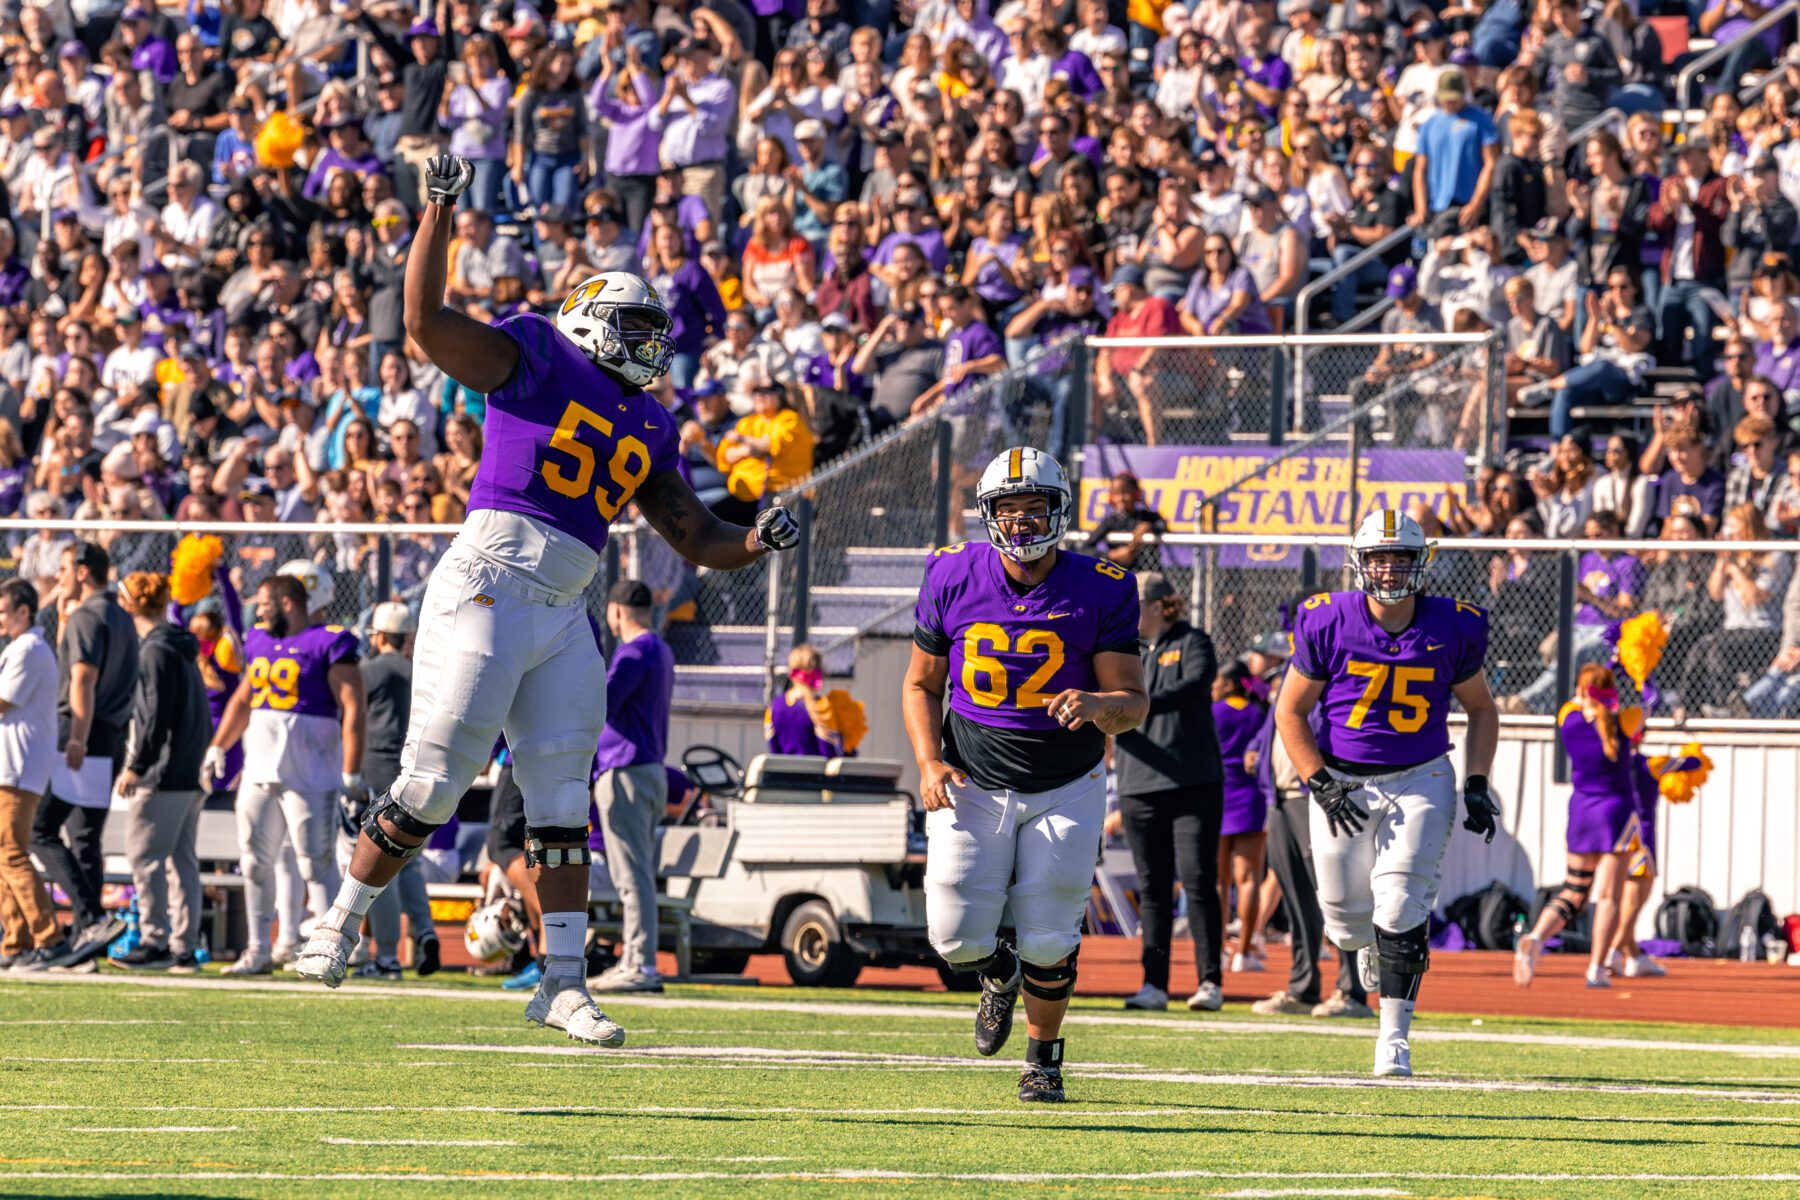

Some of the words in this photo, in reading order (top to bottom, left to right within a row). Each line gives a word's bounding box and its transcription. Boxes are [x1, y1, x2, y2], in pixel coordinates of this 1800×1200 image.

[541, 400, 652, 522] 59
[1175, 456, 1265, 482] HOME
[1313, 457, 1372, 482] THE
[1087, 488, 1204, 523] GLD
[250, 656, 301, 710] 99
[961, 622, 1064, 709] 62
[1345, 660, 1435, 733] 75
